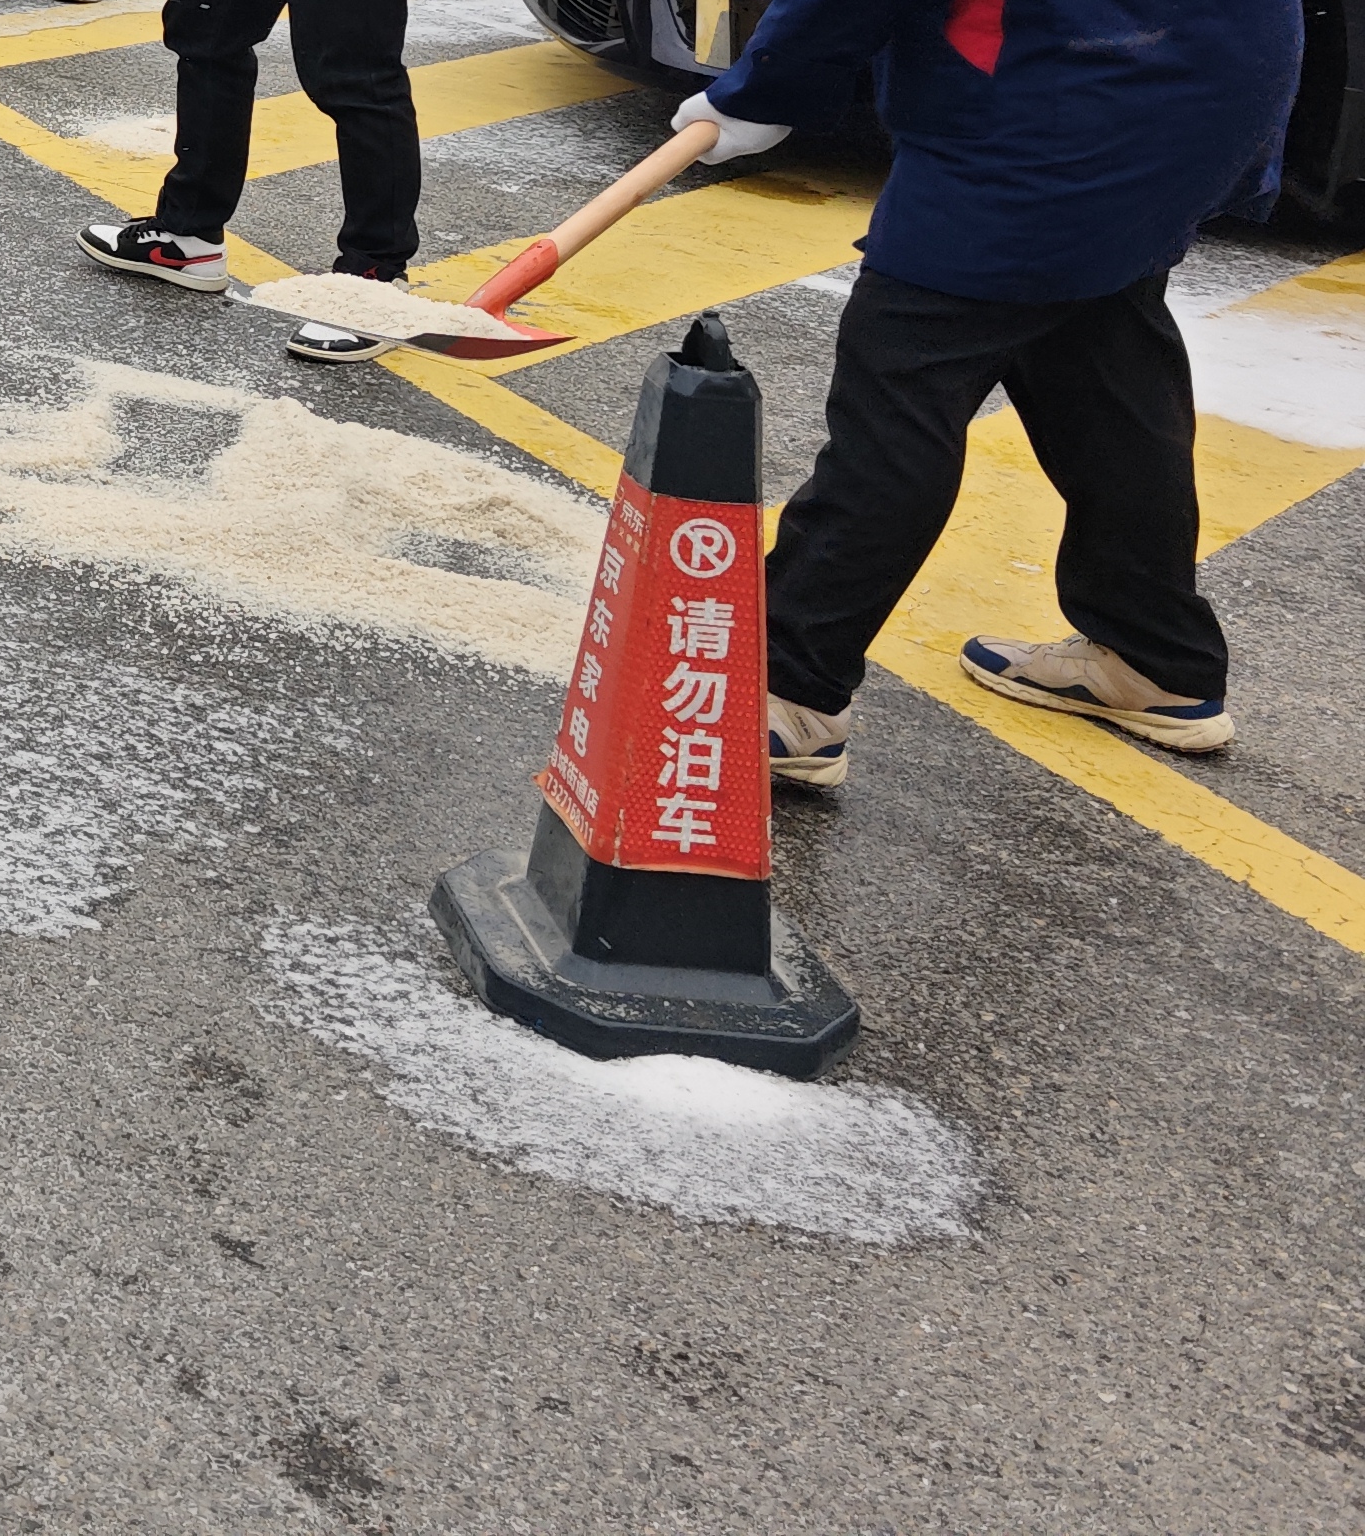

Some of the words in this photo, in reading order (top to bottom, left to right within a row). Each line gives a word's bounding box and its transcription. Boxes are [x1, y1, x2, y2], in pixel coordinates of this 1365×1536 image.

[569, 542, 626, 758] 京东家电
[651, 595, 736, 853] 请勿泊车
